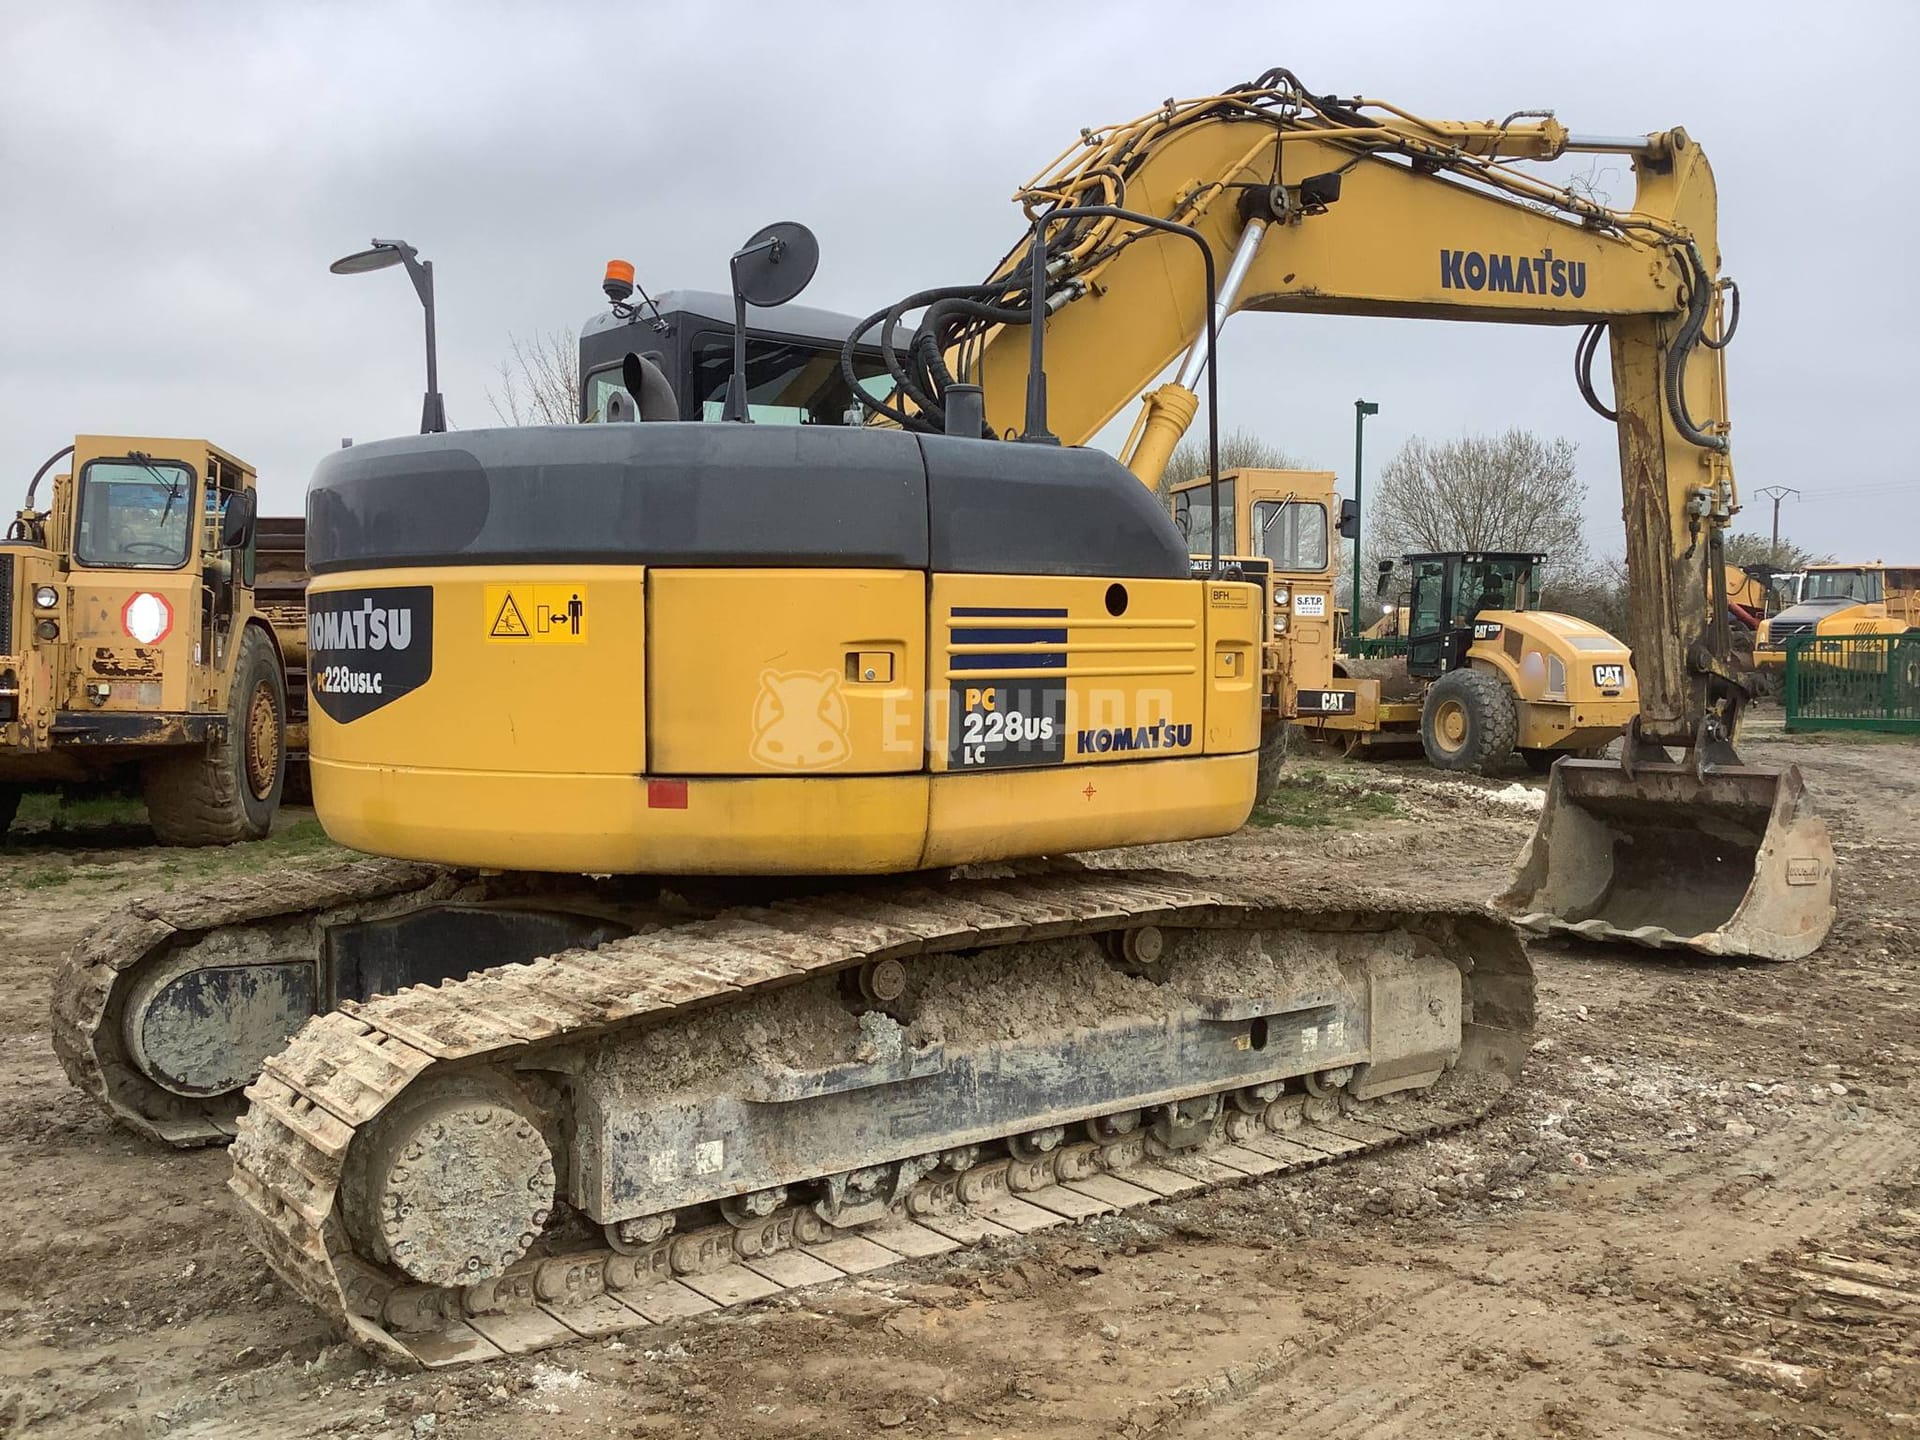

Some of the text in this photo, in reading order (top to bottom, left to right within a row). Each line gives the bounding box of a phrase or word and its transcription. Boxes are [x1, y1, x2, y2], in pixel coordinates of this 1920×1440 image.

[1440, 248, 1586, 298] KOMATSU
[1474, 624, 1488, 639] CAT
[1595, 666, 1621, 686] CAT
[965, 687, 996, 712] PC
[1321, 692, 1345, 711] CAT
[1077, 718, 1193, 754] KOMATSU
[963, 745, 986, 765] LC
